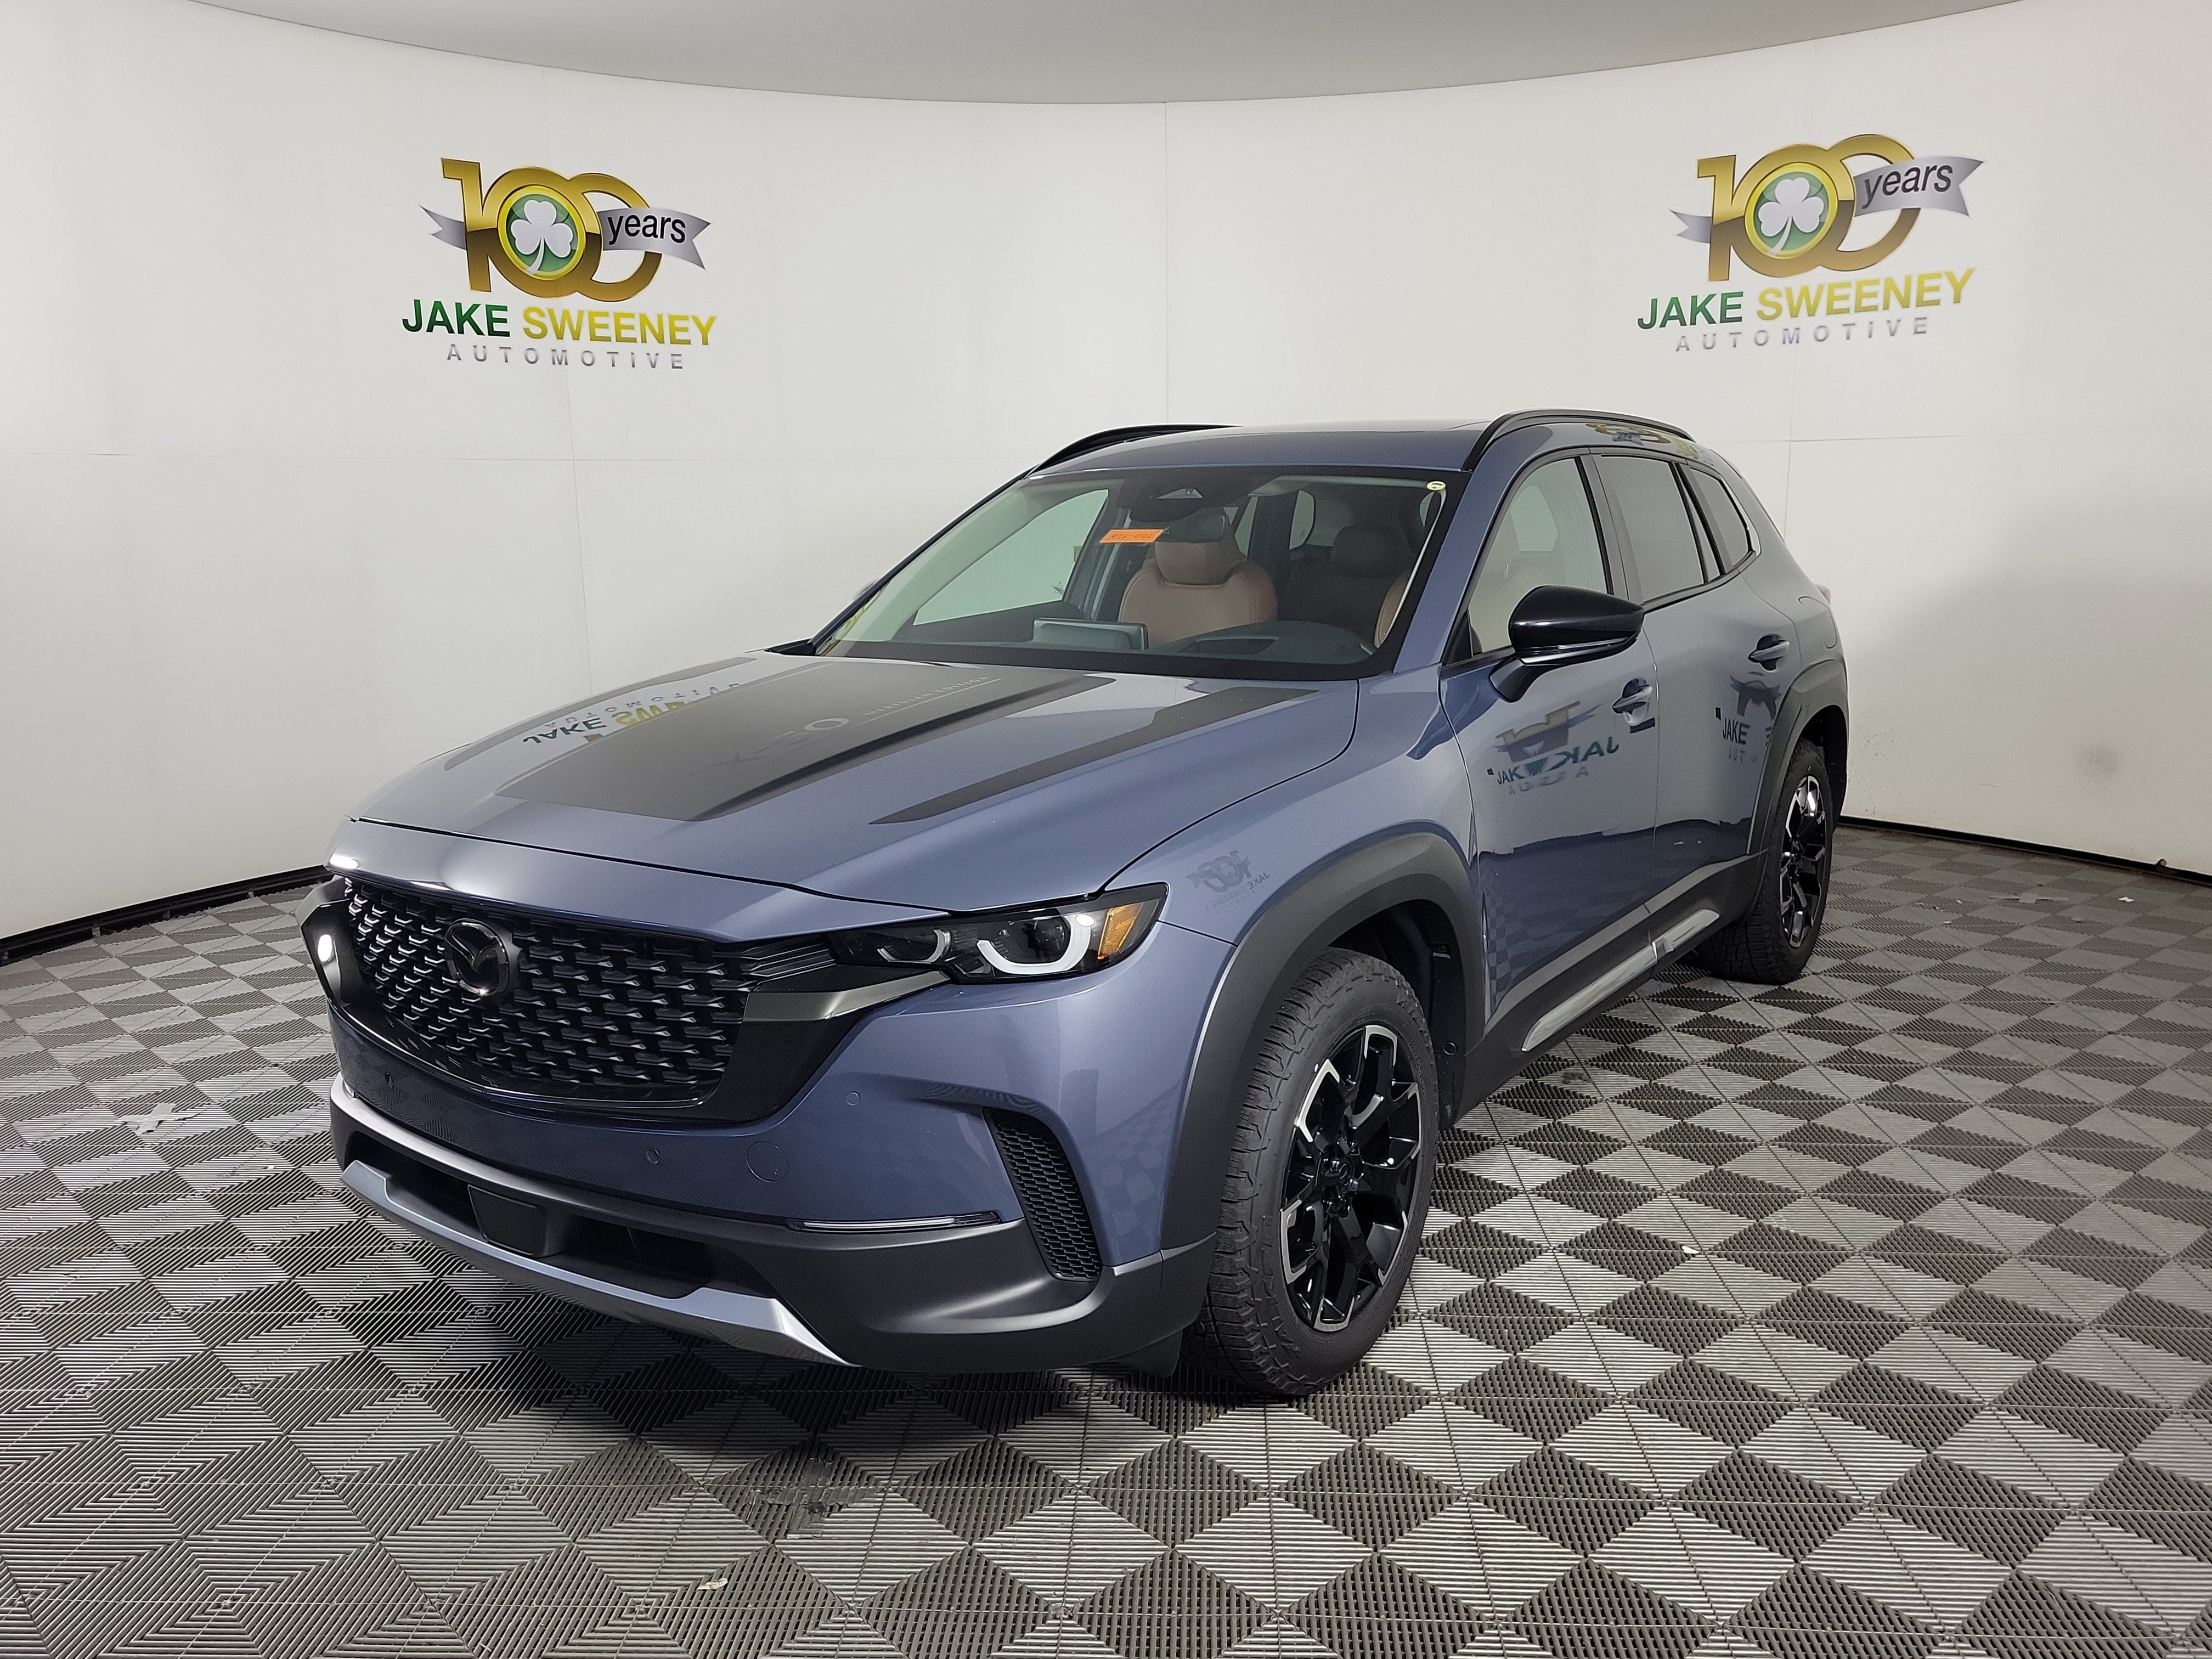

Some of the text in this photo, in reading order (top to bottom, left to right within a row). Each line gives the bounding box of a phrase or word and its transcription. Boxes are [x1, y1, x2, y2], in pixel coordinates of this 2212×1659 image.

[1697, 133, 1921, 282] 100
[1862, 164, 1954, 210] years
[441, 157, 663, 303] 100
[608, 214, 687, 245] years
[1637, 267, 1976, 330] JAKE SWEENEY
[402, 299, 717, 347] JAKE SWEENEY
[1675, 317, 1929, 353] AUTOMOTIVE
[446, 343, 684, 370] AUTOMOTIVE
[1723, 718, 1750, 745] JAKE
